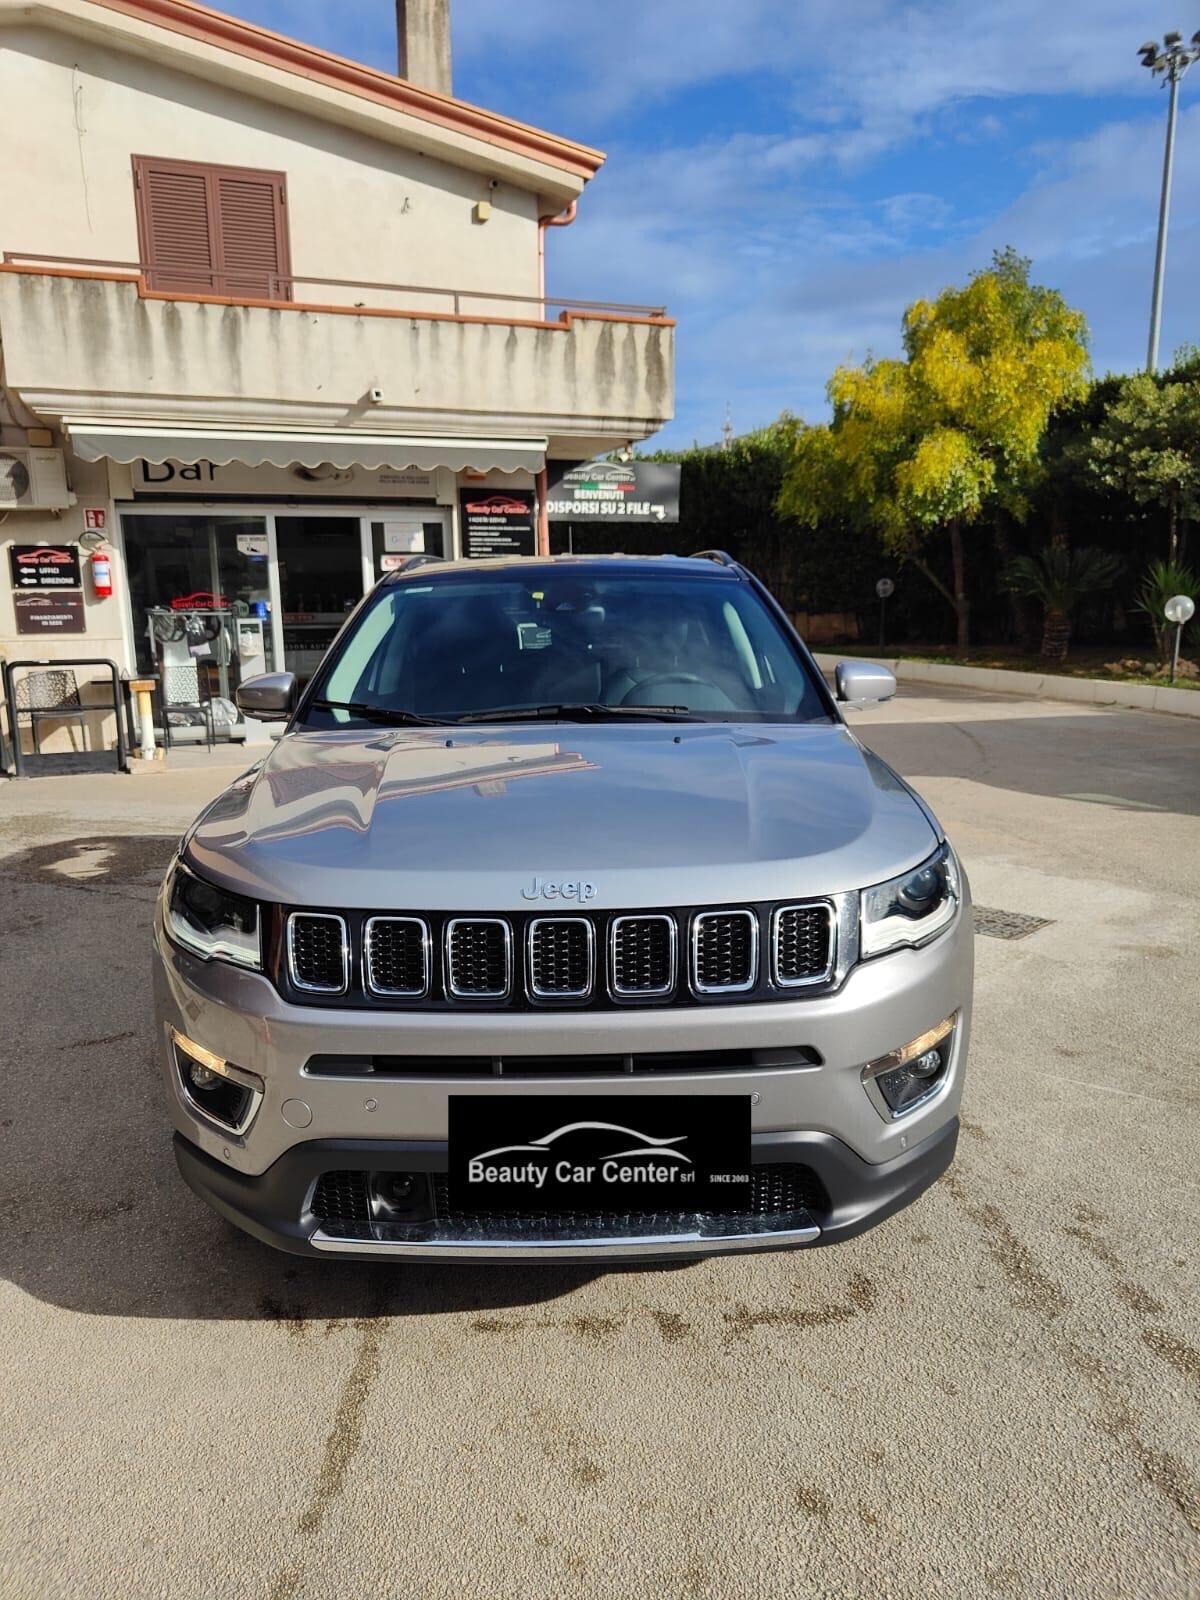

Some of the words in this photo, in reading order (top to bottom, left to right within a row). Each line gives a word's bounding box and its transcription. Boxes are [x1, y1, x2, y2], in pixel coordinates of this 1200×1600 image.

[574, 489, 624, 500] BENVENUTI
[546, 501, 599, 514] DISPORSI
[600, 502, 616, 514] SU
[617, 503, 626, 515] 2
[627, 502, 651, 515] FILE
[520, 876, 598, 903] Jeep
